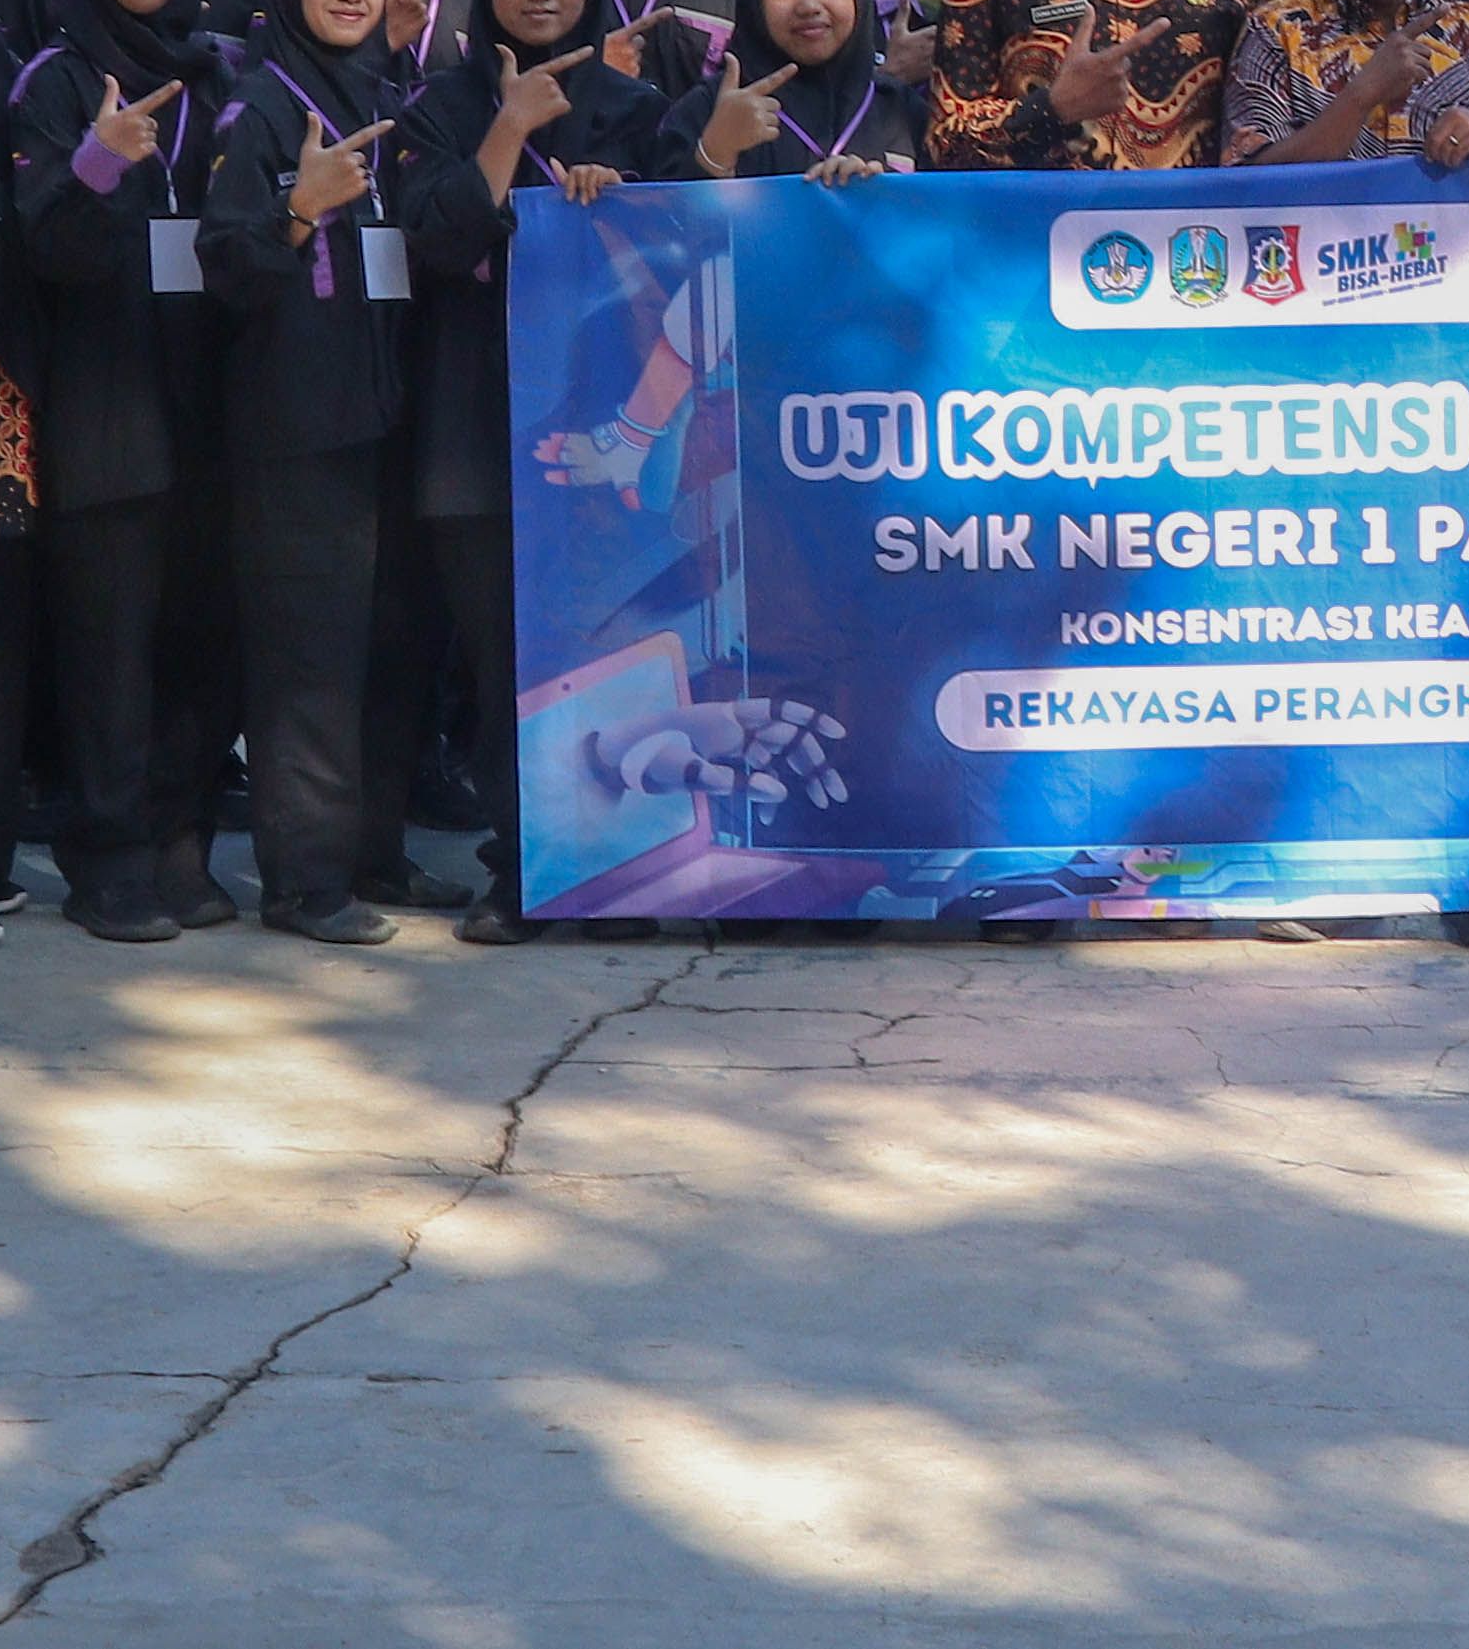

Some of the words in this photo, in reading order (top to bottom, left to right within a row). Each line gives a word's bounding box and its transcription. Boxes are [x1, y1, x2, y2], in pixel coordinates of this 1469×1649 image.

[1318, 233, 1390, 277] SMK
[1338, 255, 1449, 293] BISA-HEBAT
[787, 398, 920, 473] UJI
[947, 392, 1461, 470] KOMPETENSI
[874, 514, 1036, 572] SMK
[1058, 507, 1340, 569] NEGERI
[1361, 507, 1396, 564] 1
[1060, 606, 1374, 645] KONSENTRASI
[985, 689, 1237, 728] REKAYASA
